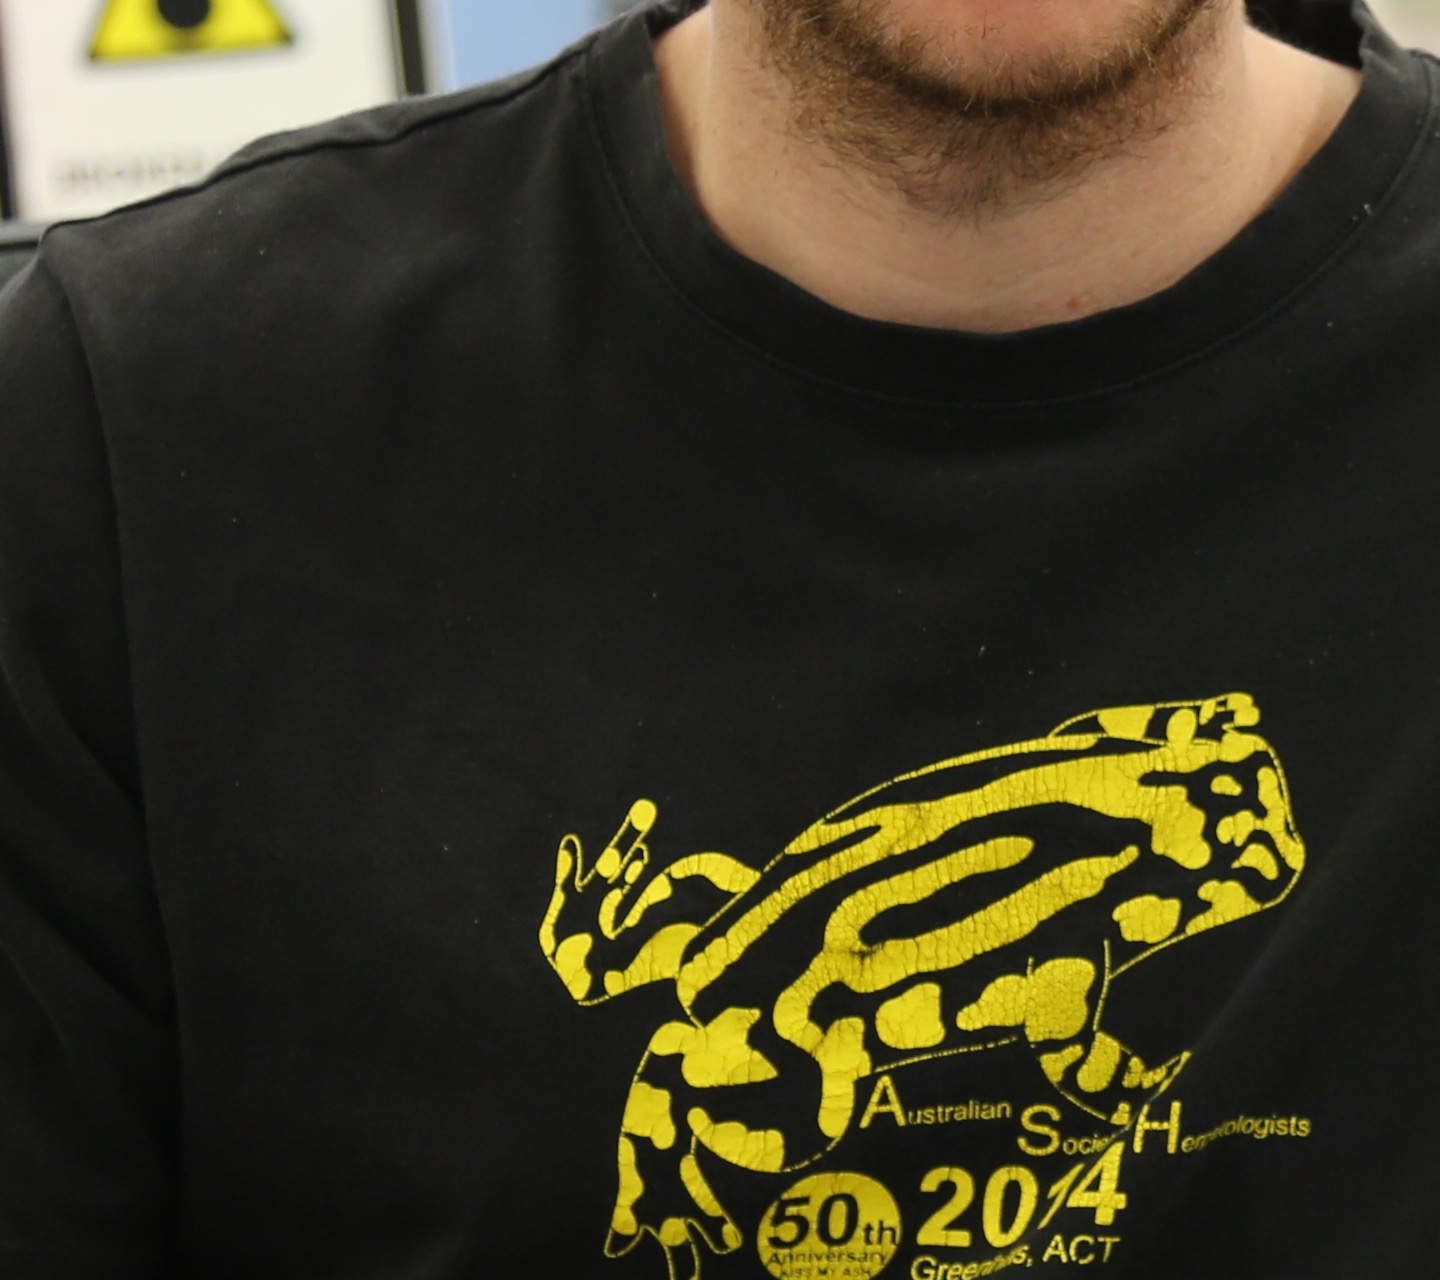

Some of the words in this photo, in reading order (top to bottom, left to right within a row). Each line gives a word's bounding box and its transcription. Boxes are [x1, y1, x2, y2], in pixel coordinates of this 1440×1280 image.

[859, 1074, 1013, 1129] Australian
[1016, 1104, 1110, 1156] Socie
[768, 1193, 896, 1249] 50th
[916, 1141, 1127, 1248] 2014
[769, 1252, 887, 1266] Anniversary
[1042, 1235, 1121, 1265] ACT
